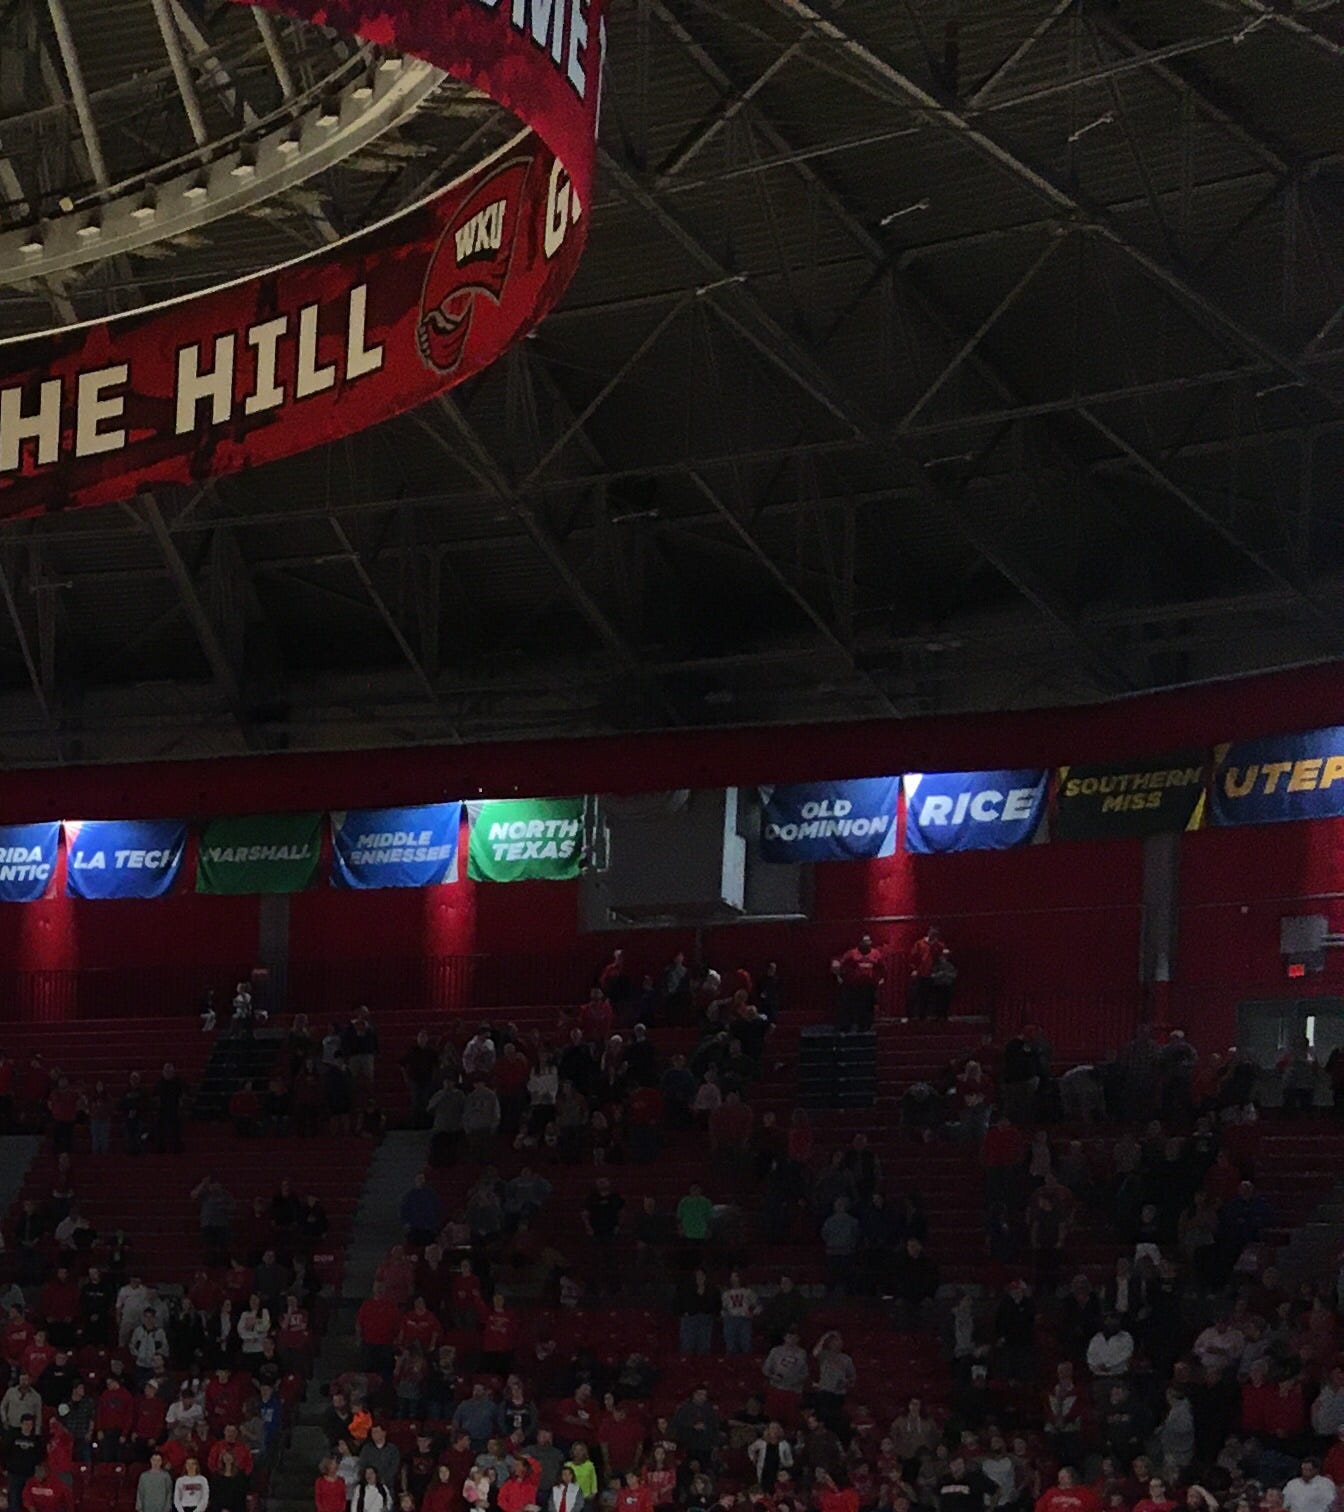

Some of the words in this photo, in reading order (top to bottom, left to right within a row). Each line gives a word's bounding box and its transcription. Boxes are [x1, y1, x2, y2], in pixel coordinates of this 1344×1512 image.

[175, 284, 383, 435] HILL
[1065, 767, 1203, 797] SOUTHERN
[801, 799, 853, 819] OLD
[918, 787, 1036, 827] RICE
[1102, 791, 1162, 813] MISS
[489, 819, 579, 841] NORTH
[765, 815, 889, 841] DOMINION
[358, 831, 433, 849] MIDDLE
[492, 840, 576, 861] TEXAS
[73, 851, 106, 870] LA
[115, 850, 180, 869] TECH
[349, 844, 452, 866] ENNESSEE
